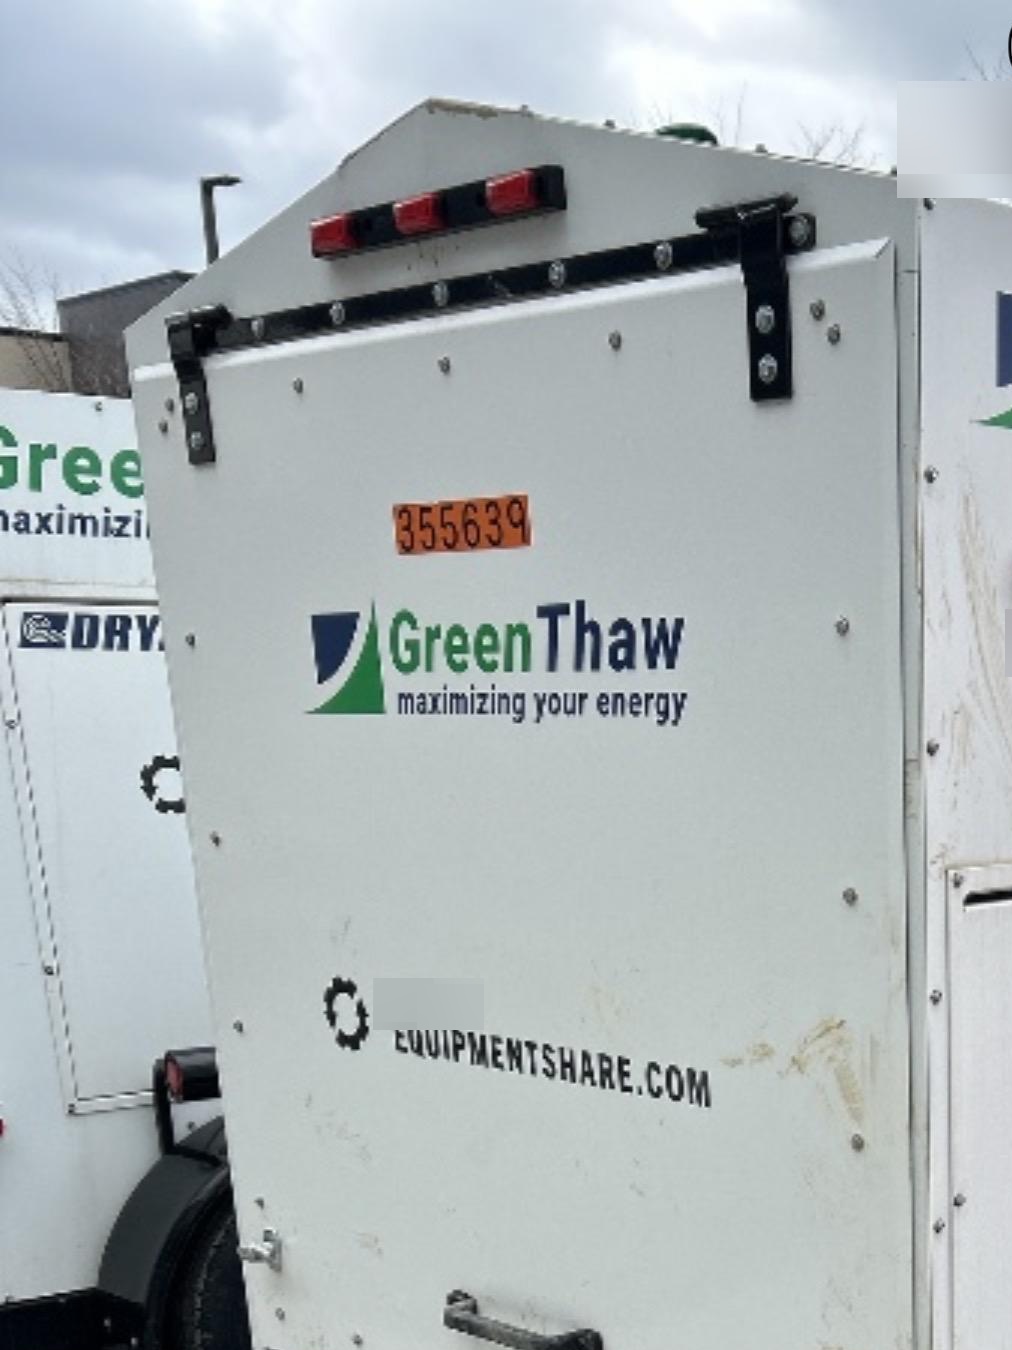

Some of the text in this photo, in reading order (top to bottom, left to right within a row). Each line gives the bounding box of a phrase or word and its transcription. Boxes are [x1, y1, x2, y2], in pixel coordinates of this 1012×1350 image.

[0, 503, 151, 539] aximizi
[398, 498, 526, 552] 355639
[71, 613, 165, 651] DRY
[389, 599, 685, 675] GreenThaw
[398, 684, 688, 726] maximizing your energy
[394, 1029, 712, 1108] EQUIPMENTSHARE.COM
